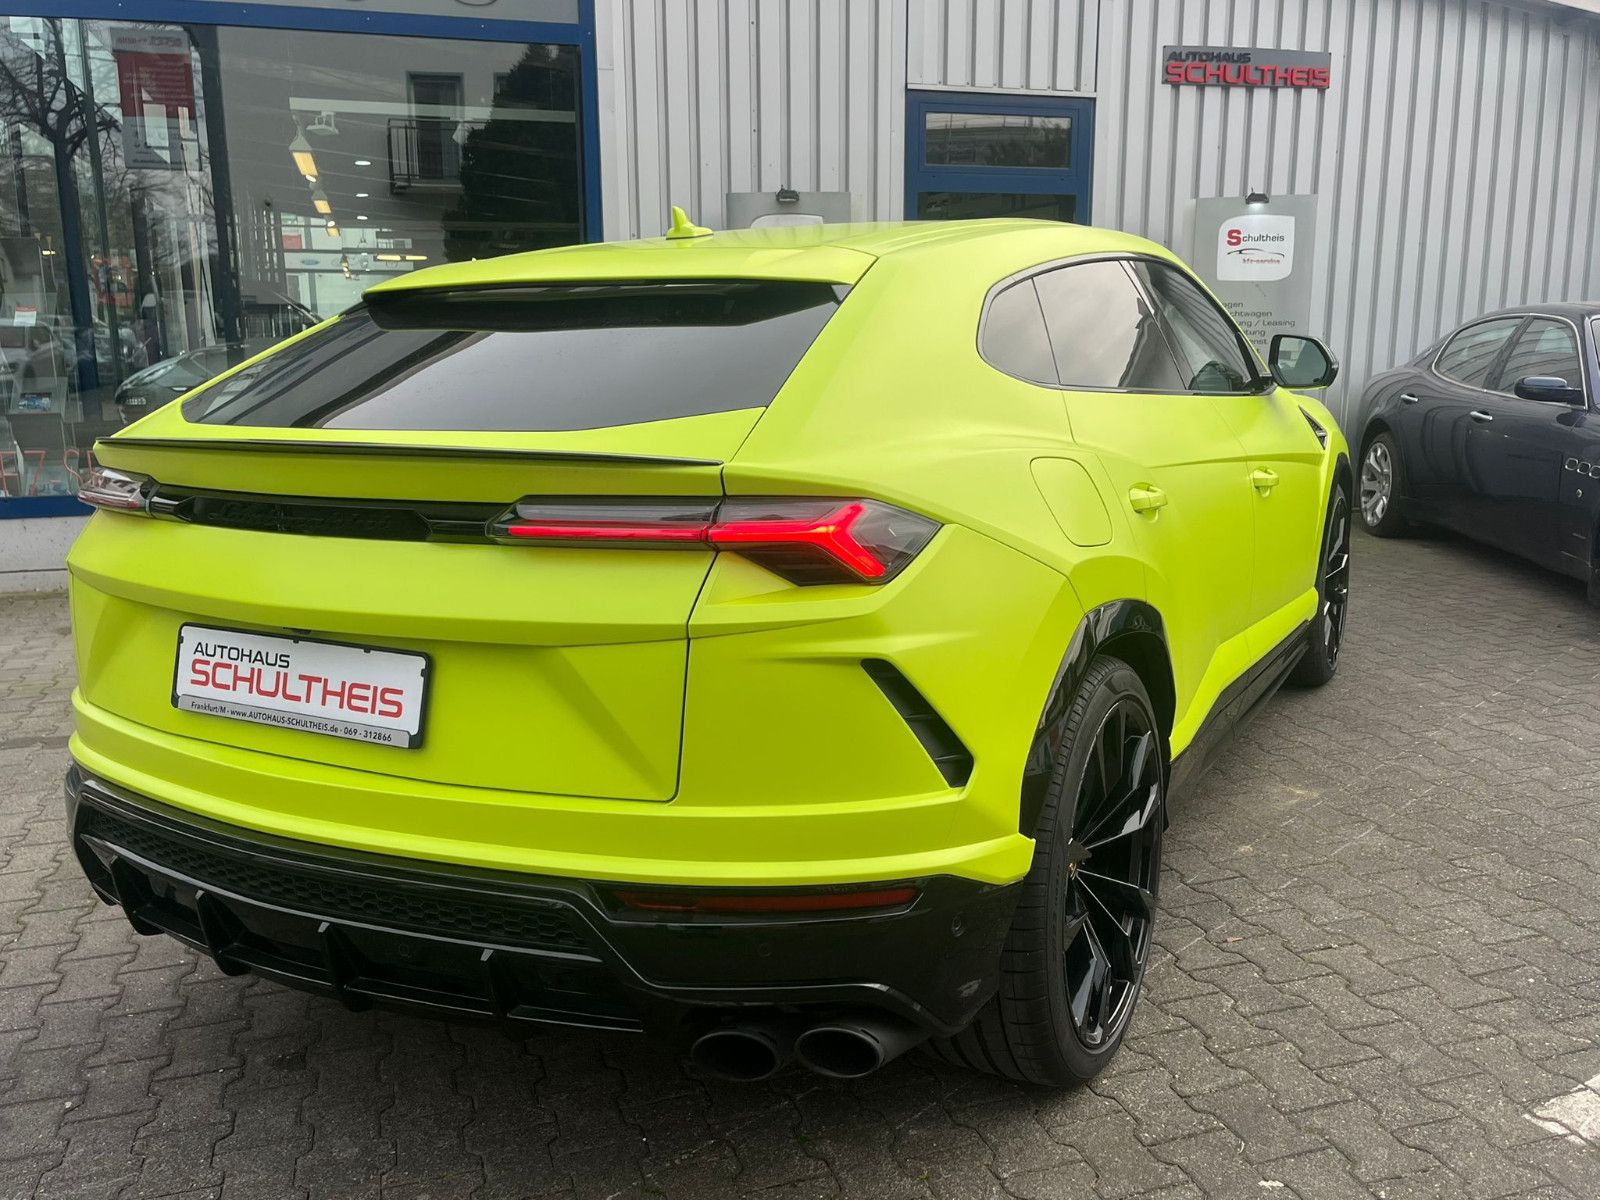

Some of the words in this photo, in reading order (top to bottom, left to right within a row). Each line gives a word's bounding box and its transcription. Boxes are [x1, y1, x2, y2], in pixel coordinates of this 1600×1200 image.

[1168, 51, 1251, 63] AUTOHAUS
[1166, 63, 1330, 87] SCHULTHEIS
[1227, 229, 1285, 247] Schultheis
[193, 642, 290, 669] AUTOHAUS
[190, 658, 404, 719] SCHULTHEIS
[191, 701, 227, 714] Frankfurt/M
[230, 709, 339, 734] www.AUTOHAUS-SCHULTHEIS.de
[343, 726, 358, 736] 069
[363, 729, 392, 742] 312866
